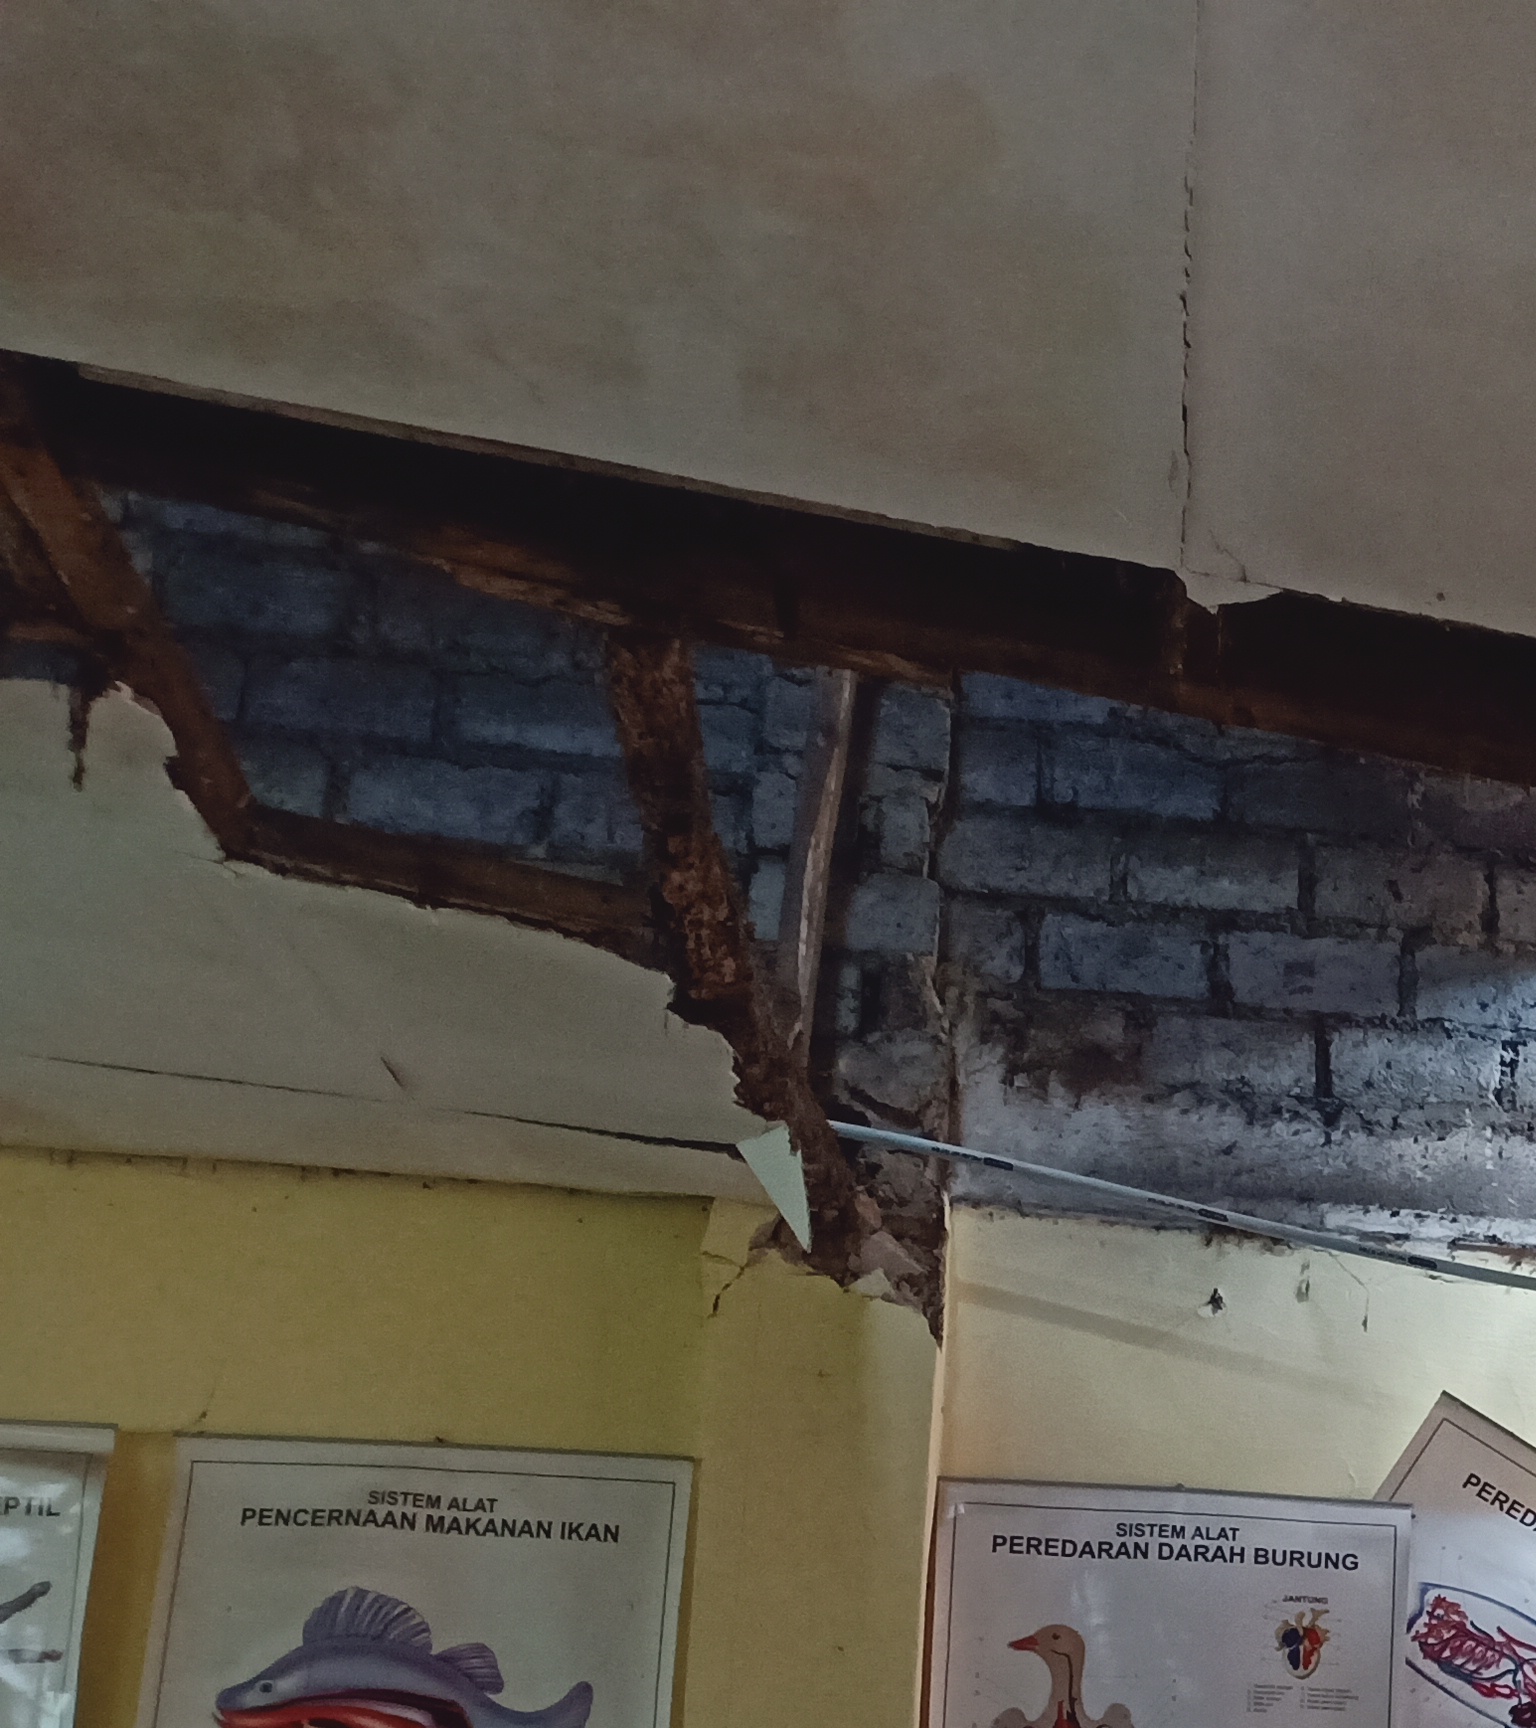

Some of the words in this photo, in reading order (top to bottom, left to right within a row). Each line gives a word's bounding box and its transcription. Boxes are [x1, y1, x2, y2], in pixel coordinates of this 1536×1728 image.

[0, 1496, 61, 1517] PTIL
[367, 1490, 441, 1511] SISTEM
[446, 1496, 498, 1513] ALAT
[241, 1508, 418, 1532] PENCERNAAN
[425, 1513, 553, 1540] MAKANAN
[559, 1521, 620, 1543] IKAN
[1116, 1522, 1185, 1540] SISTEM
[1191, 1526, 1239, 1542] ALAT
[991, 1534, 1149, 1560] PEREDARAN
[1157, 1542, 1245, 1564] DARAH
[1253, 1547, 1359, 1571] BURUNG
